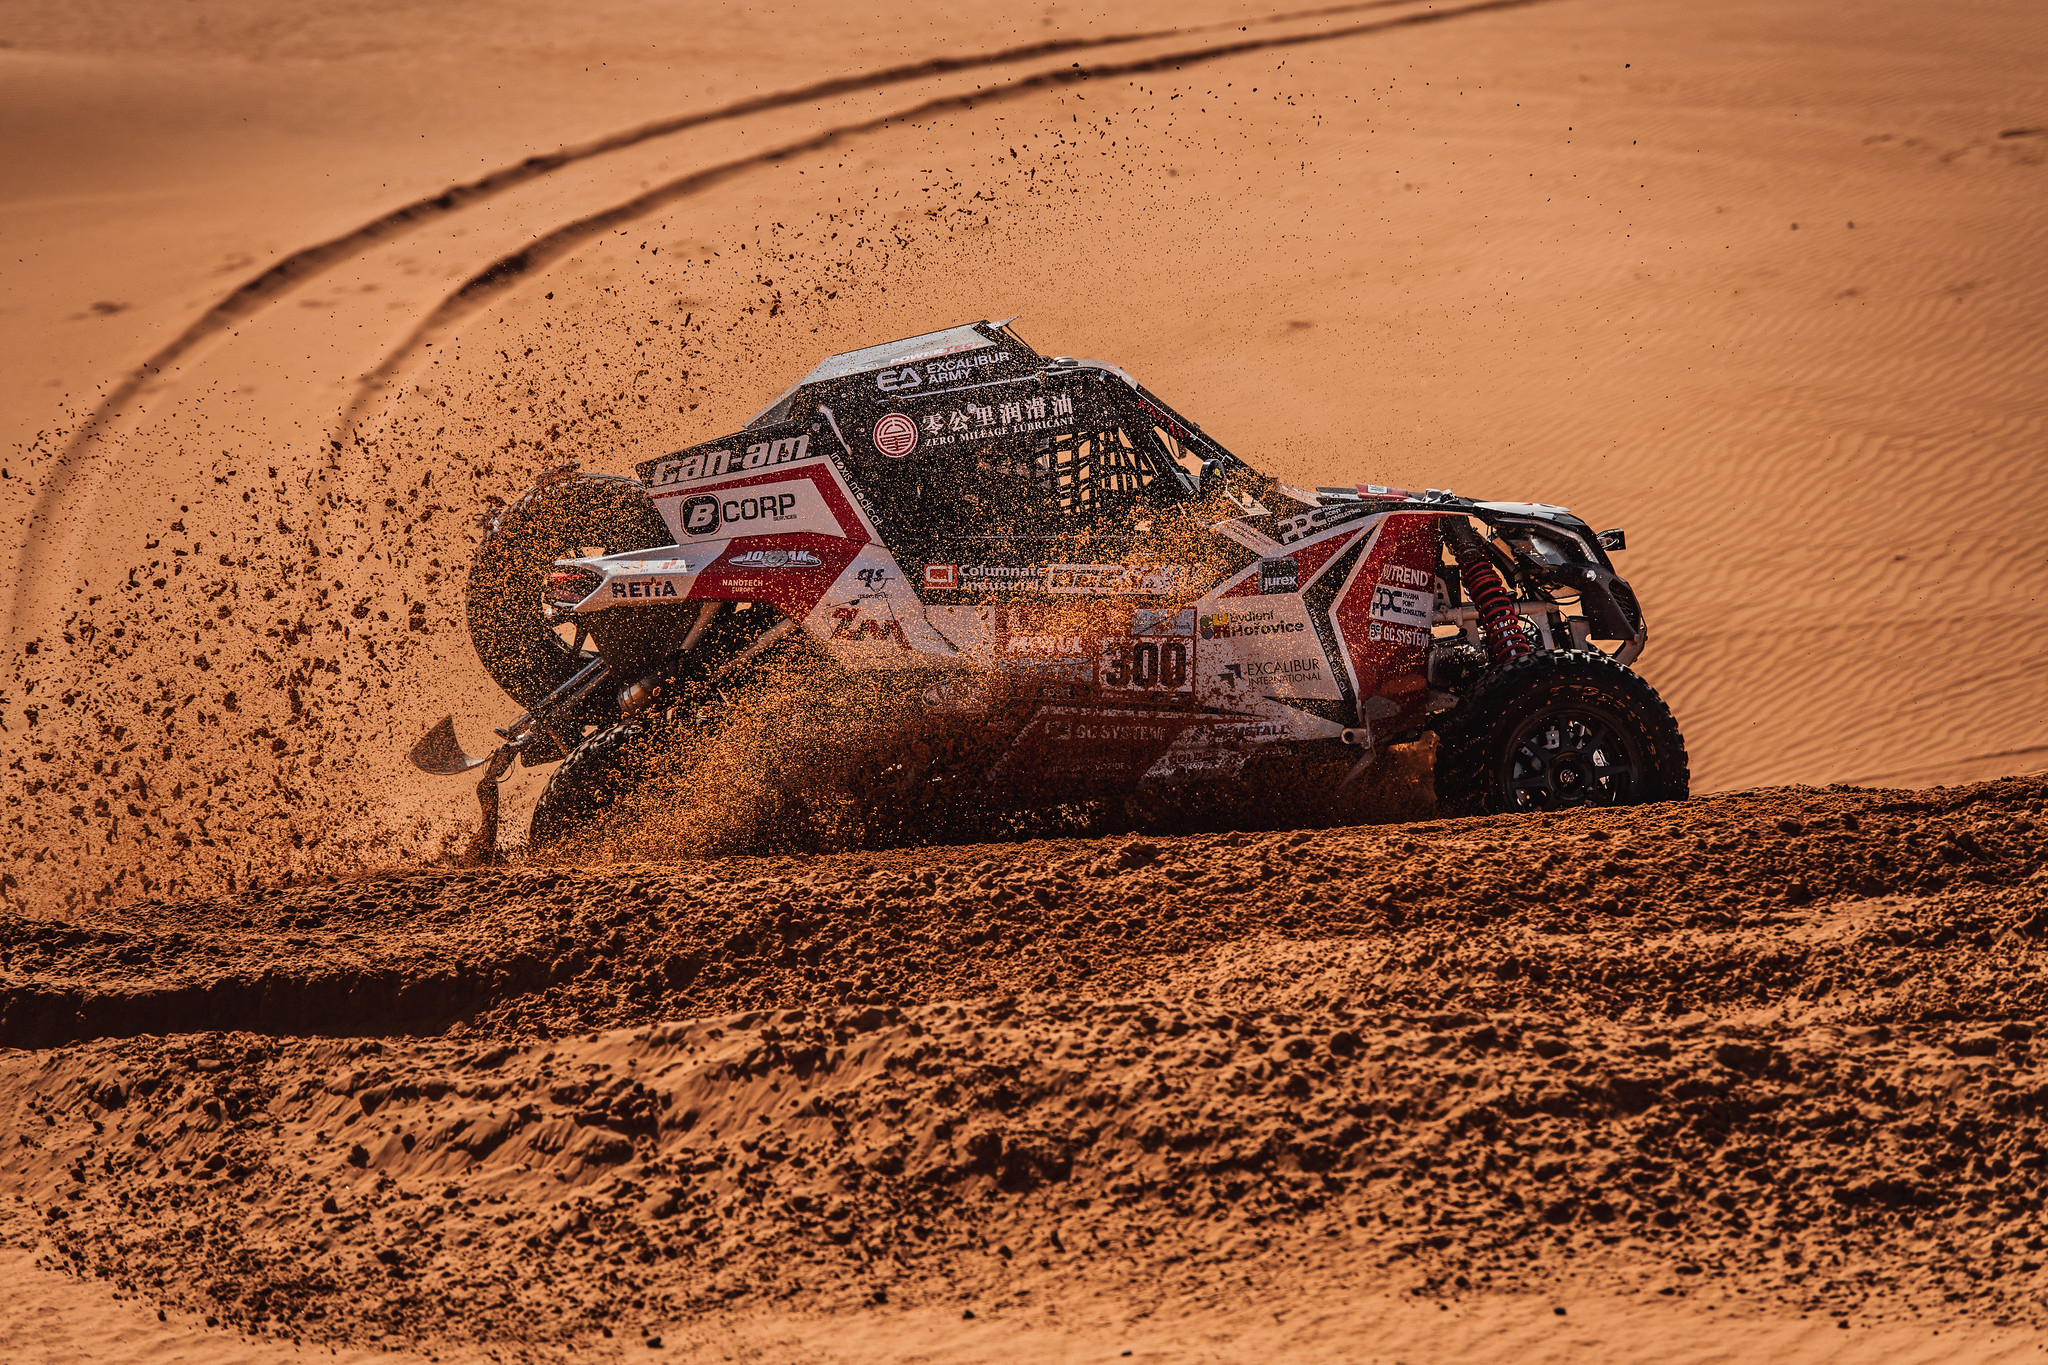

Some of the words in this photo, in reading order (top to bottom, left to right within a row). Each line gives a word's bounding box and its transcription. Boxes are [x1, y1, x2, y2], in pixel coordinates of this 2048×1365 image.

[927, 352, 1010, 374] EXCALIBUR
[928, 368, 973, 385] ARMY
[922, 394, 1074, 435] 零公里润滑油
[925, 435, 955, 447] ZERO
[959, 426, 1009, 442] MILEAGE
[1013, 416, 1075, 433] LUBRICANT
[651, 434, 812, 486] can-am
[722, 493, 796, 523] CORP
[849, 481, 883, 527] medical
[722, 579, 763, 587] NANOTECH
[1263, 575, 1298, 591] jurex
[1383, 626, 1396, 641] GC
[1396, 629, 1430, 648] SYSTEM
[1102, 641, 1187, 687] 300
[1247, 658, 1320, 676] EXCALIBUR
[1248, 672, 1321, 686] INTERNATIONAL
